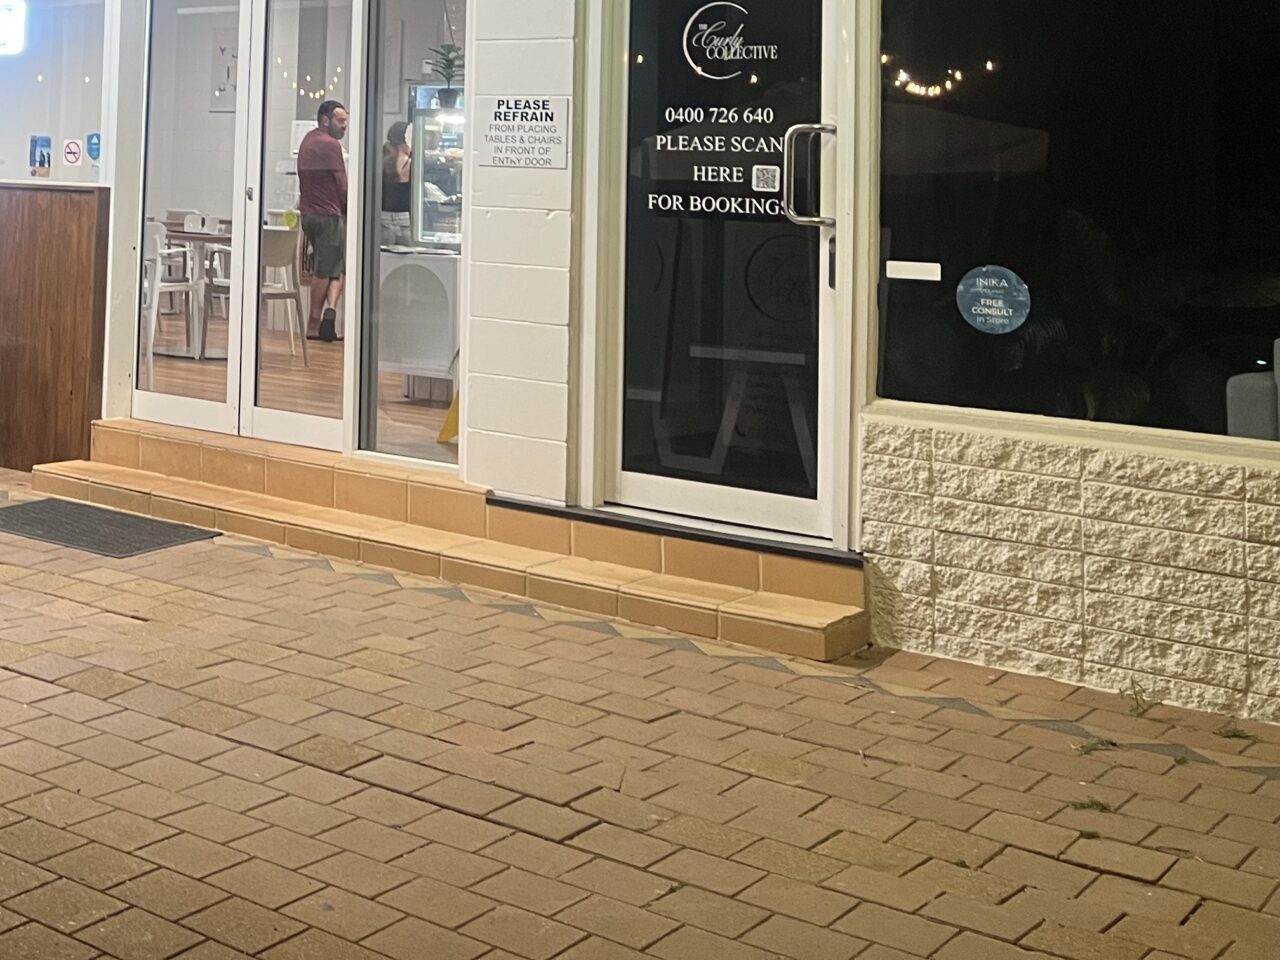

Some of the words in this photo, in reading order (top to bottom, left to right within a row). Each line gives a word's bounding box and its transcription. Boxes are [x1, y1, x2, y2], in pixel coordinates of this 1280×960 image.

[706, 44, 779, 60] COLLECTIVE
[497, 100, 550, 110] PLEASE
[494, 111, 554, 122] REFRAIN
[664, 106, 704, 124] 0400
[708, 106, 739, 124] 726
[743, 106, 775, 124] 640
[489, 123, 515, 134] FROM
[517, 124, 558, 135] PLACING
[484, 134, 518, 145] TABLES
[519, 135, 526, 145] &
[527, 135, 563, 146] CHAIRS
[655, 134, 726, 152] PLEASE
[730, 135, 784, 153] SCAN
[494, 145, 504, 155] IN
[505, 145, 536, 156] FRONT
[537, 146, 552, 156] OF
[492, 156, 522, 166] ENTRY
[524, 157, 553, 167] DOOR
[692, 165, 745, 183] HERE
[647, 193, 685, 211] FOR
[980, 298, 1004, 307] FREE
[971, 306, 1014, 317] CONSULT
